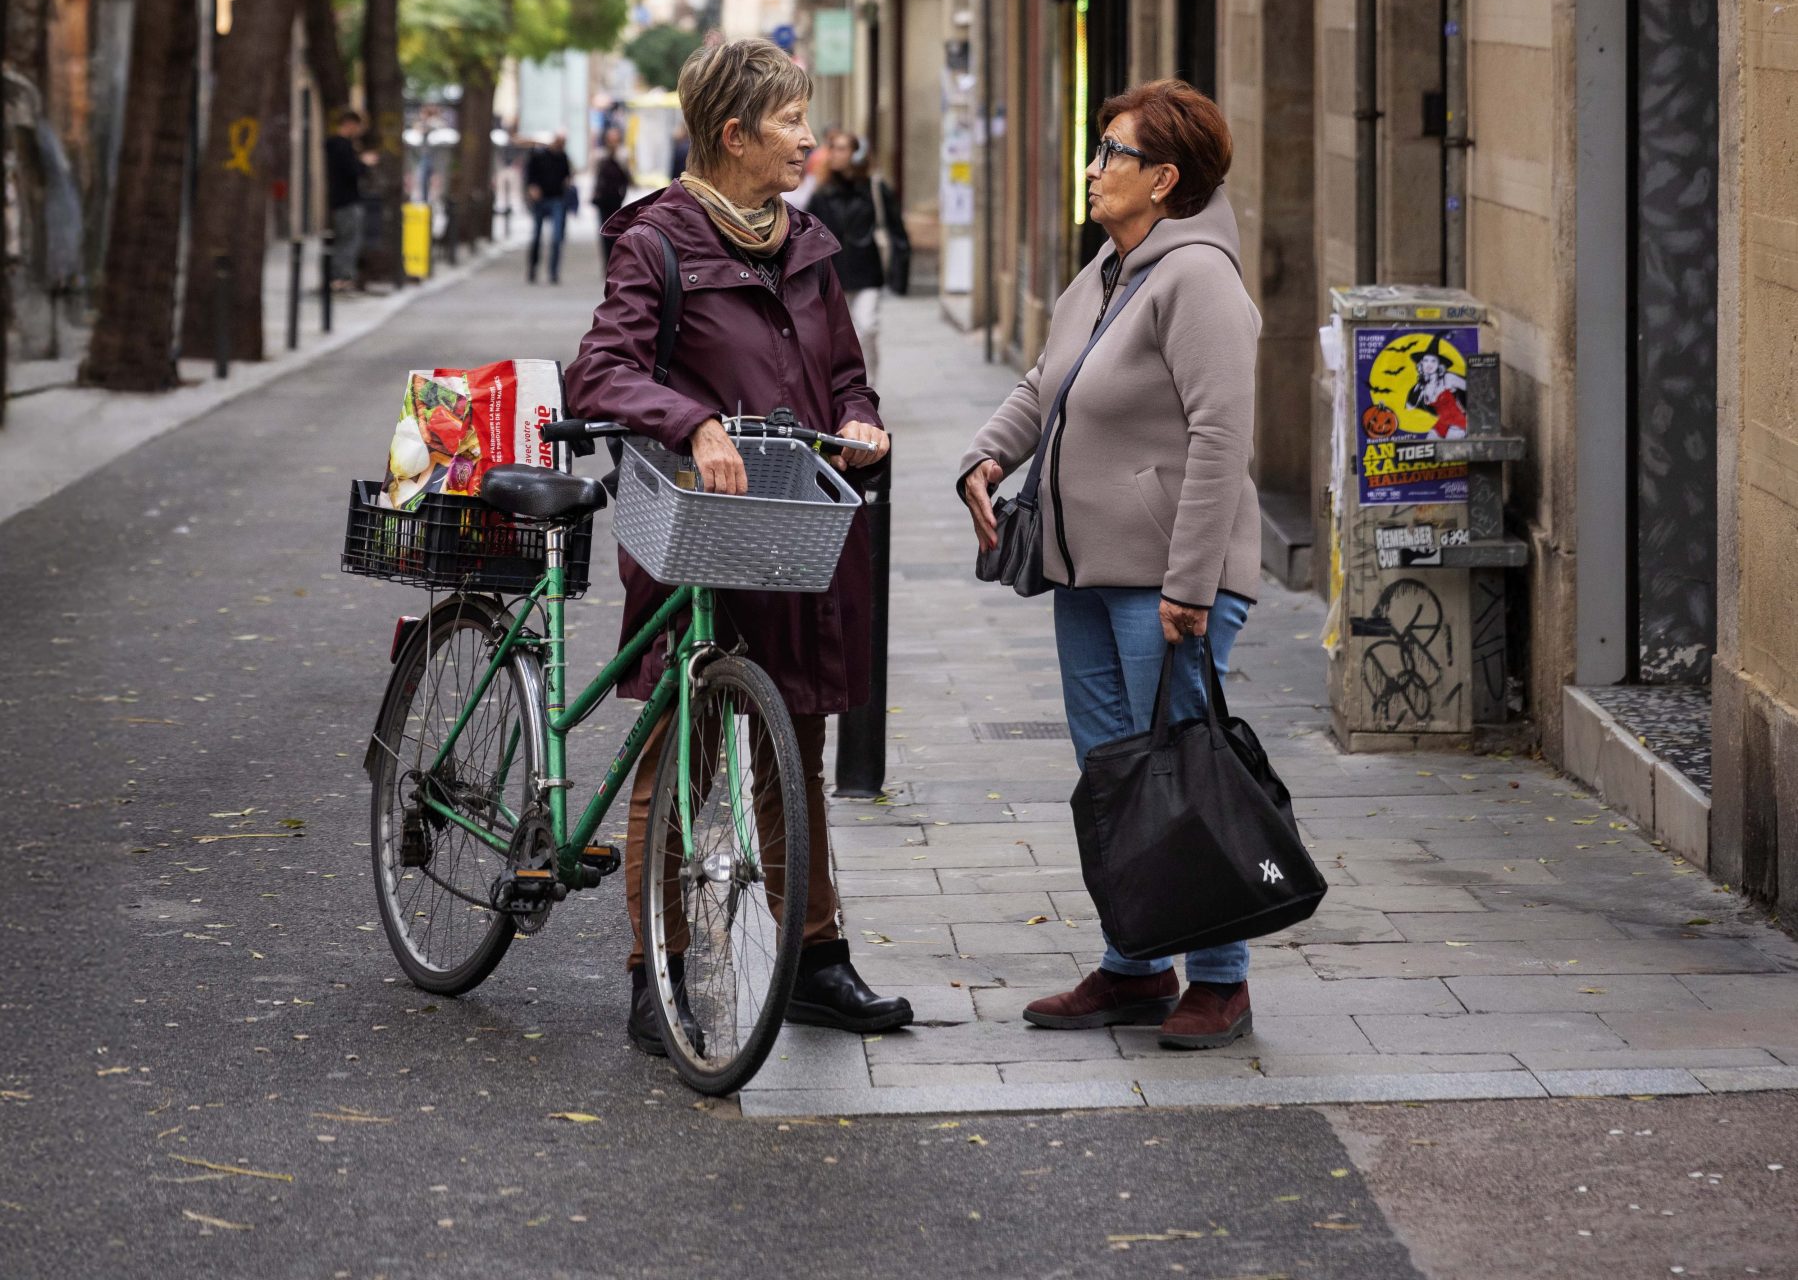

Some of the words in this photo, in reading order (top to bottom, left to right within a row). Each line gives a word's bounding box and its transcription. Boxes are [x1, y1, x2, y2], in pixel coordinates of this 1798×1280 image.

[490, 413, 495, 422] LA
[495, 413, 501, 421] DE
[524, 420, 532, 441] votre
[1397, 443, 1434, 461] TOES
[1368, 464, 1468, 489] HALLOWEEN
[1376, 525, 1434, 550] REMEMBER
[1379, 548, 1401, 569] OUR
